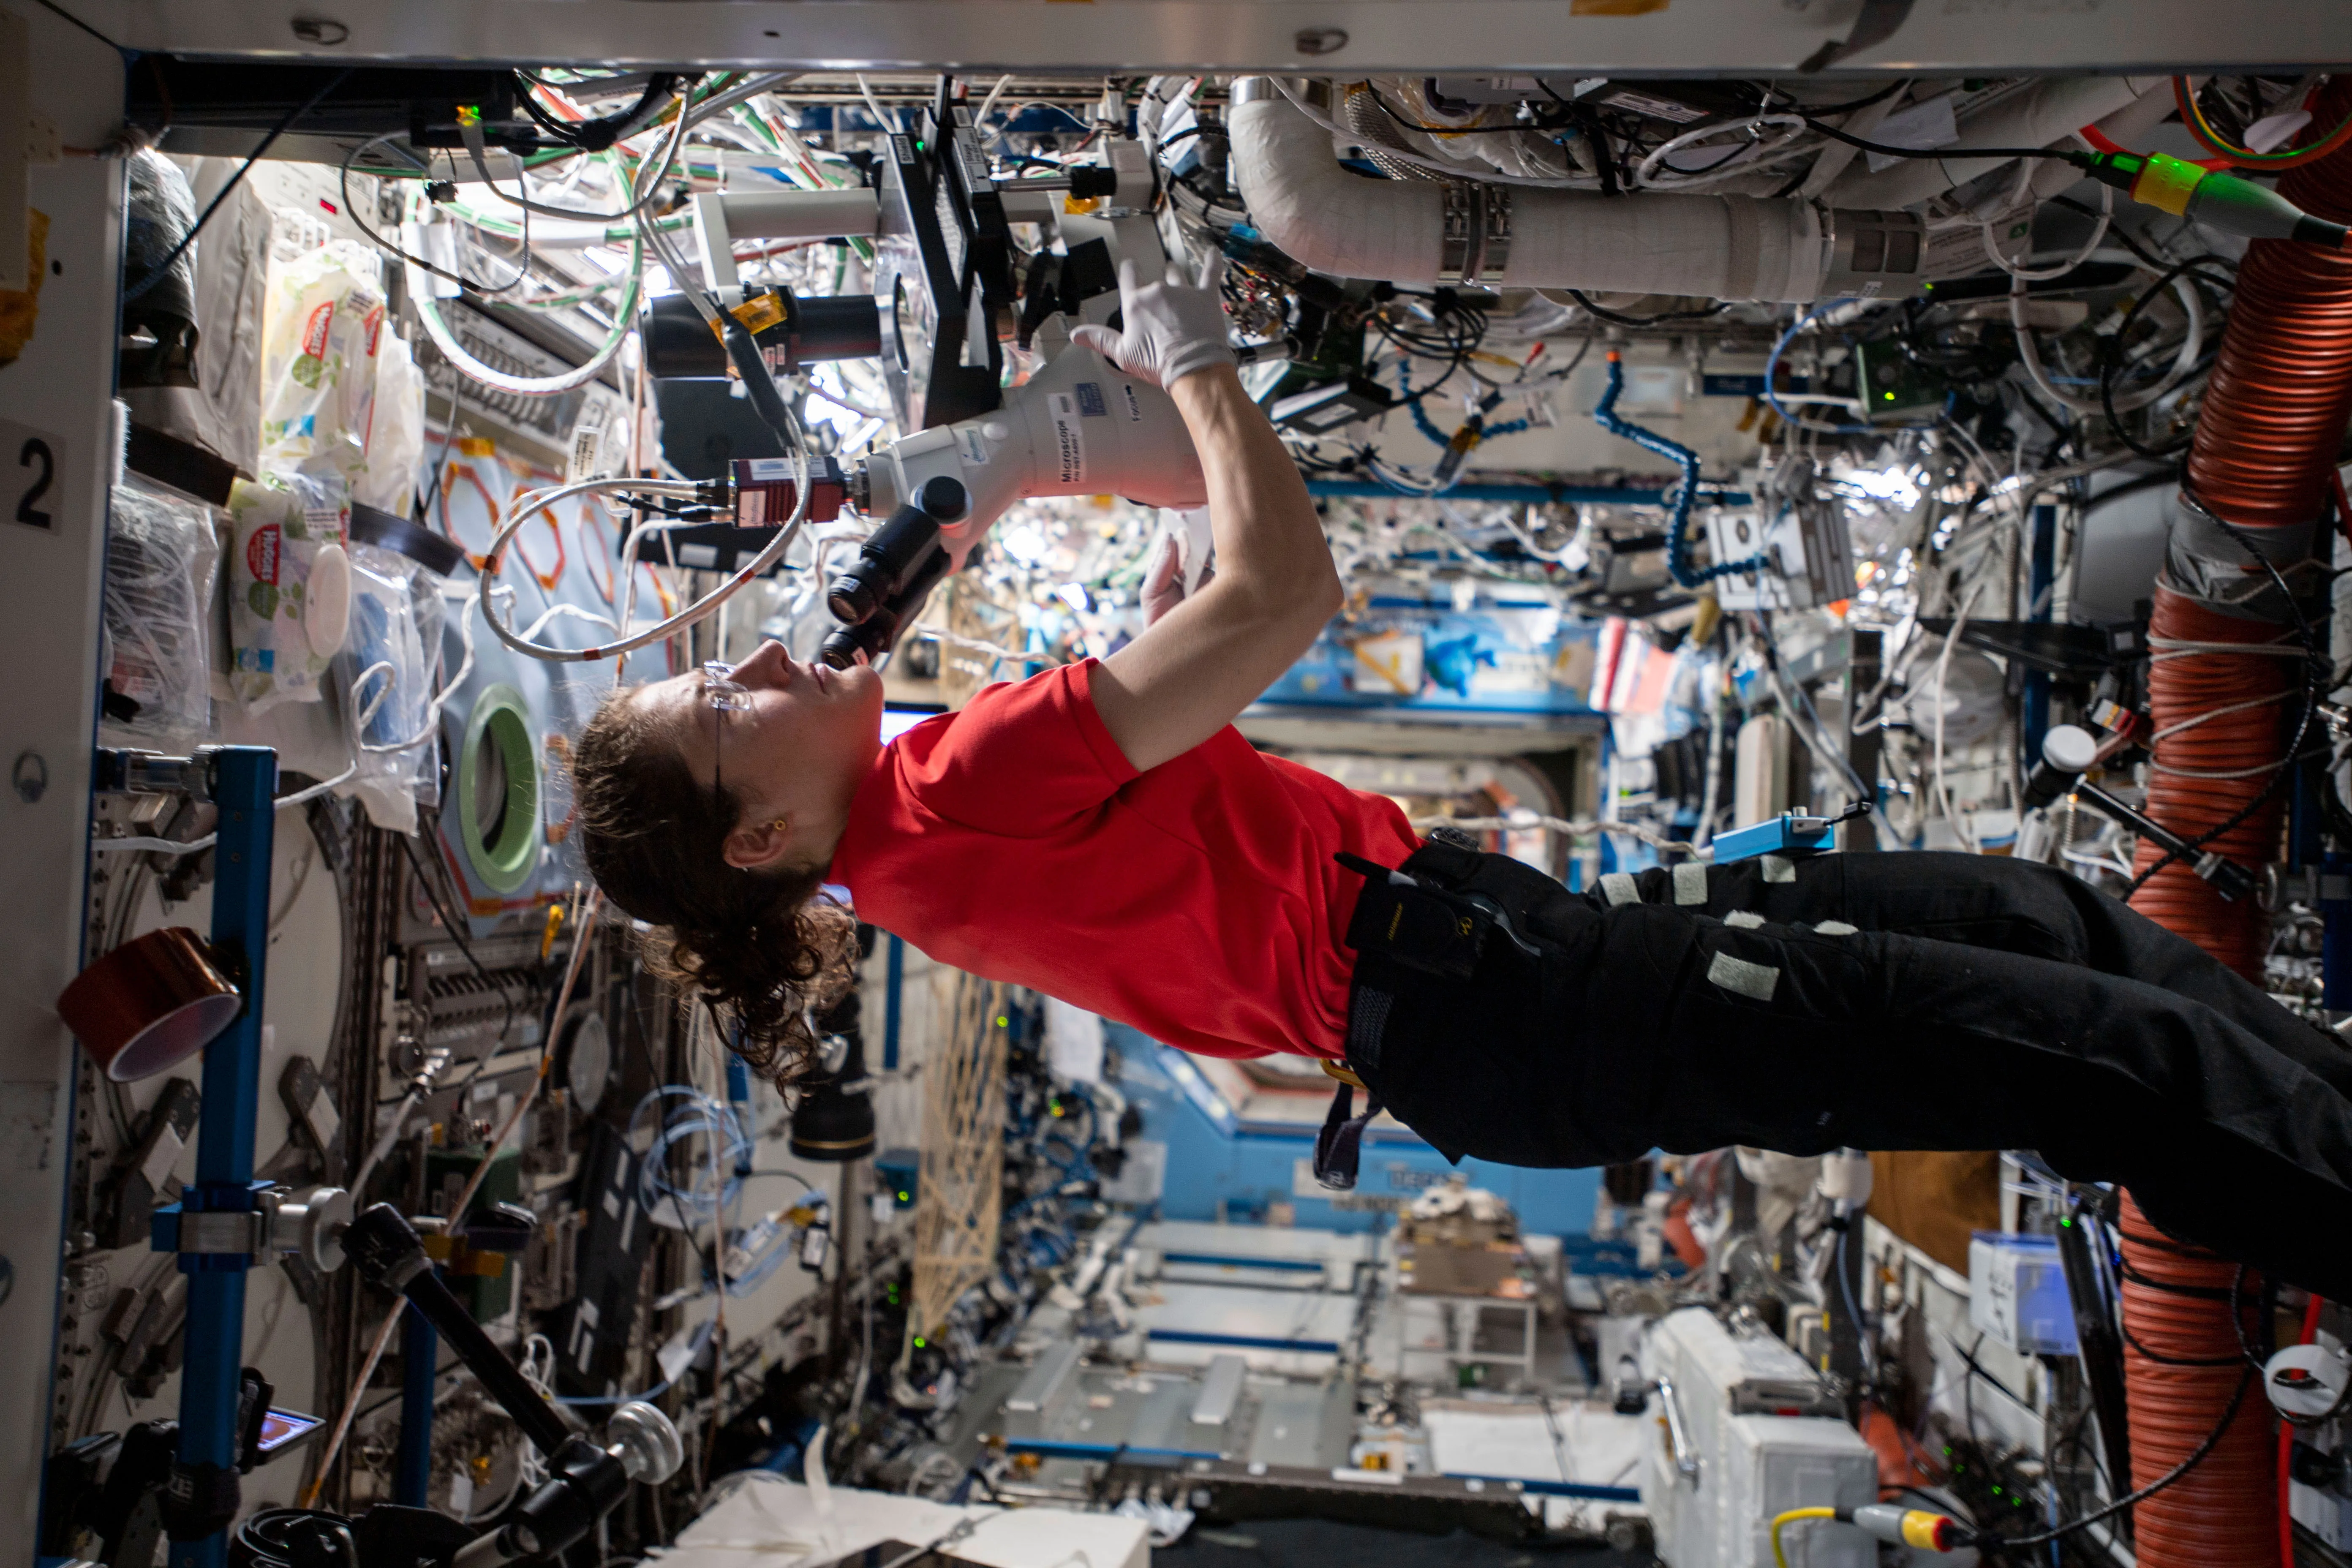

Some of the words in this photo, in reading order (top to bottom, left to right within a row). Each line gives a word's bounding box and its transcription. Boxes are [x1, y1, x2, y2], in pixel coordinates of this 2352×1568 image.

[964, 143, 973, 162] Stage
[1057, 420, 1073, 482] Microscope
[16, 437, 54, 529] 2
